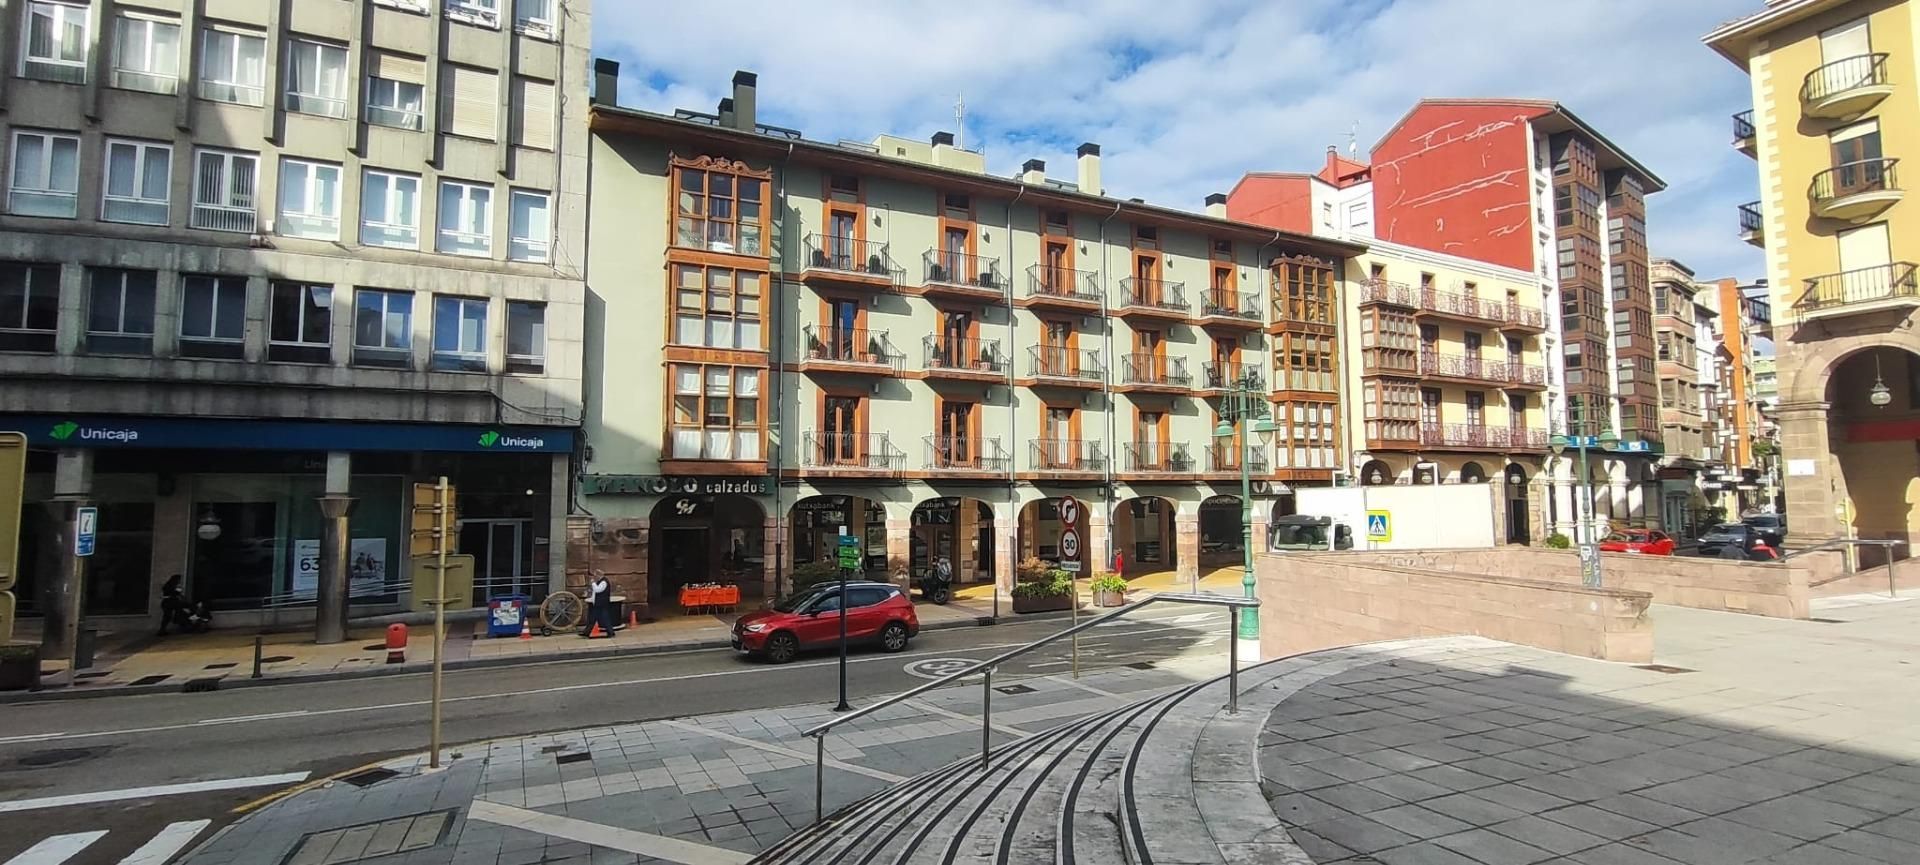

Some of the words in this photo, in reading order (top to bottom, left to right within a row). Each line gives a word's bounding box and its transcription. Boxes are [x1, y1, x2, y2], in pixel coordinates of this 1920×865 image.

[80, 428, 138, 442] Unicaja
[501, 437, 544, 449] Unicaja
[595, 475, 698, 493] MANOLO
[706, 480, 766, 493] calzados
[1064, 539, 1076, 550] 30
